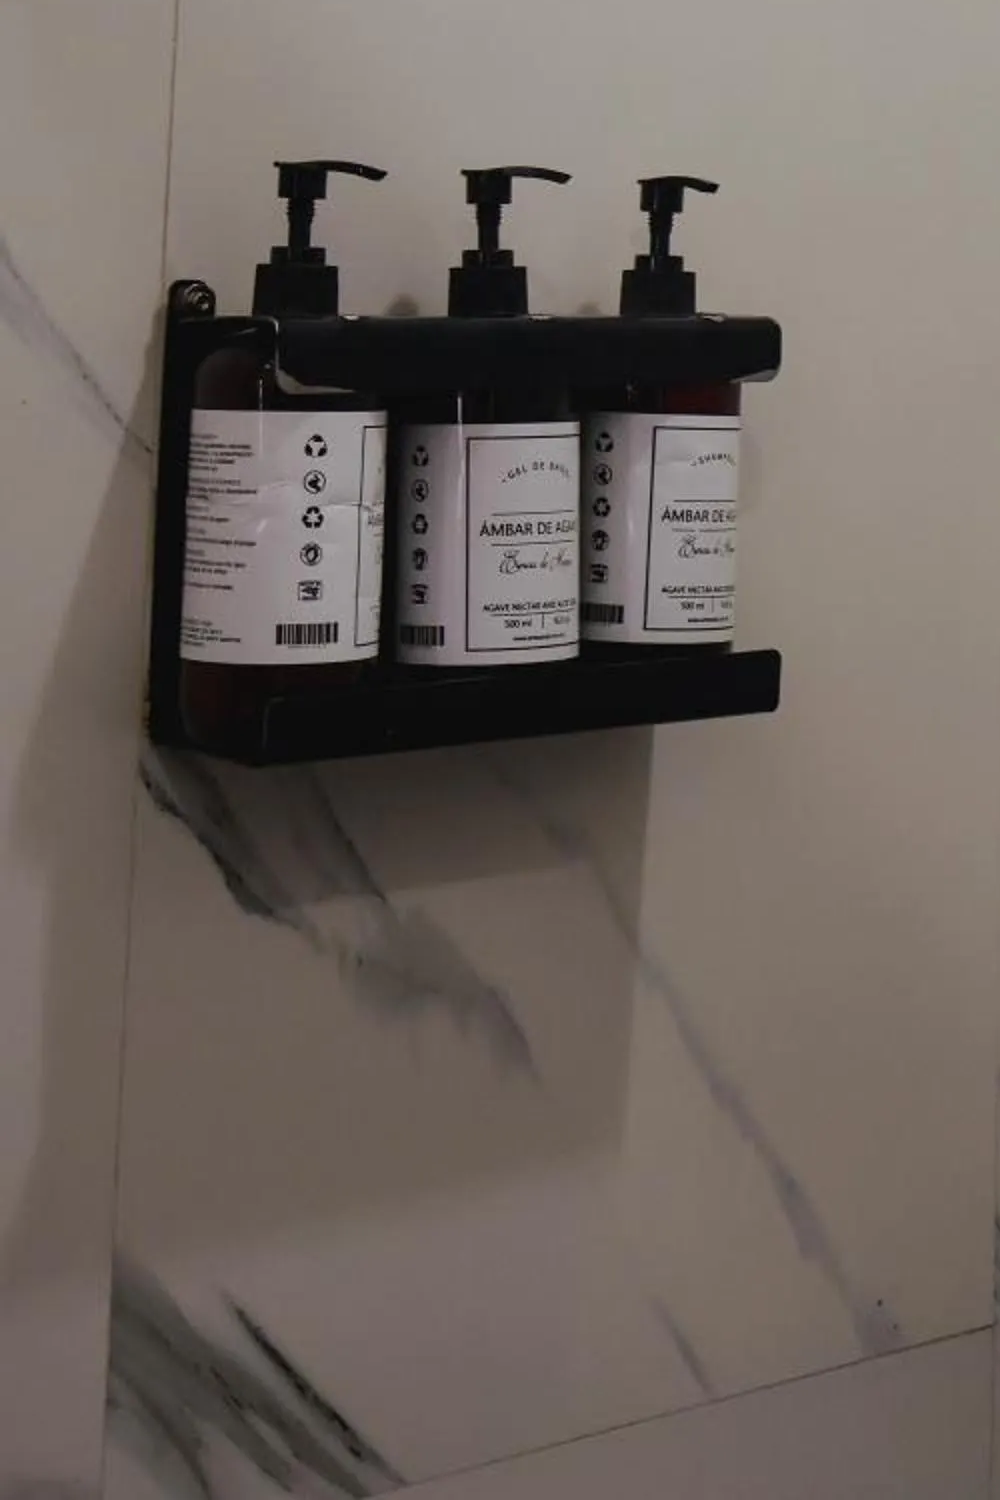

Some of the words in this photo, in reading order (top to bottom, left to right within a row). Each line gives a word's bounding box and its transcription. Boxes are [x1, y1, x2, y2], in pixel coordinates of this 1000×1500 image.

[711, 509, 725, 523] DE
[479, 519, 534, 538] ÁMBAR
[537, 521, 554, 535] DE
[482, 602, 511, 613] AGAVE
